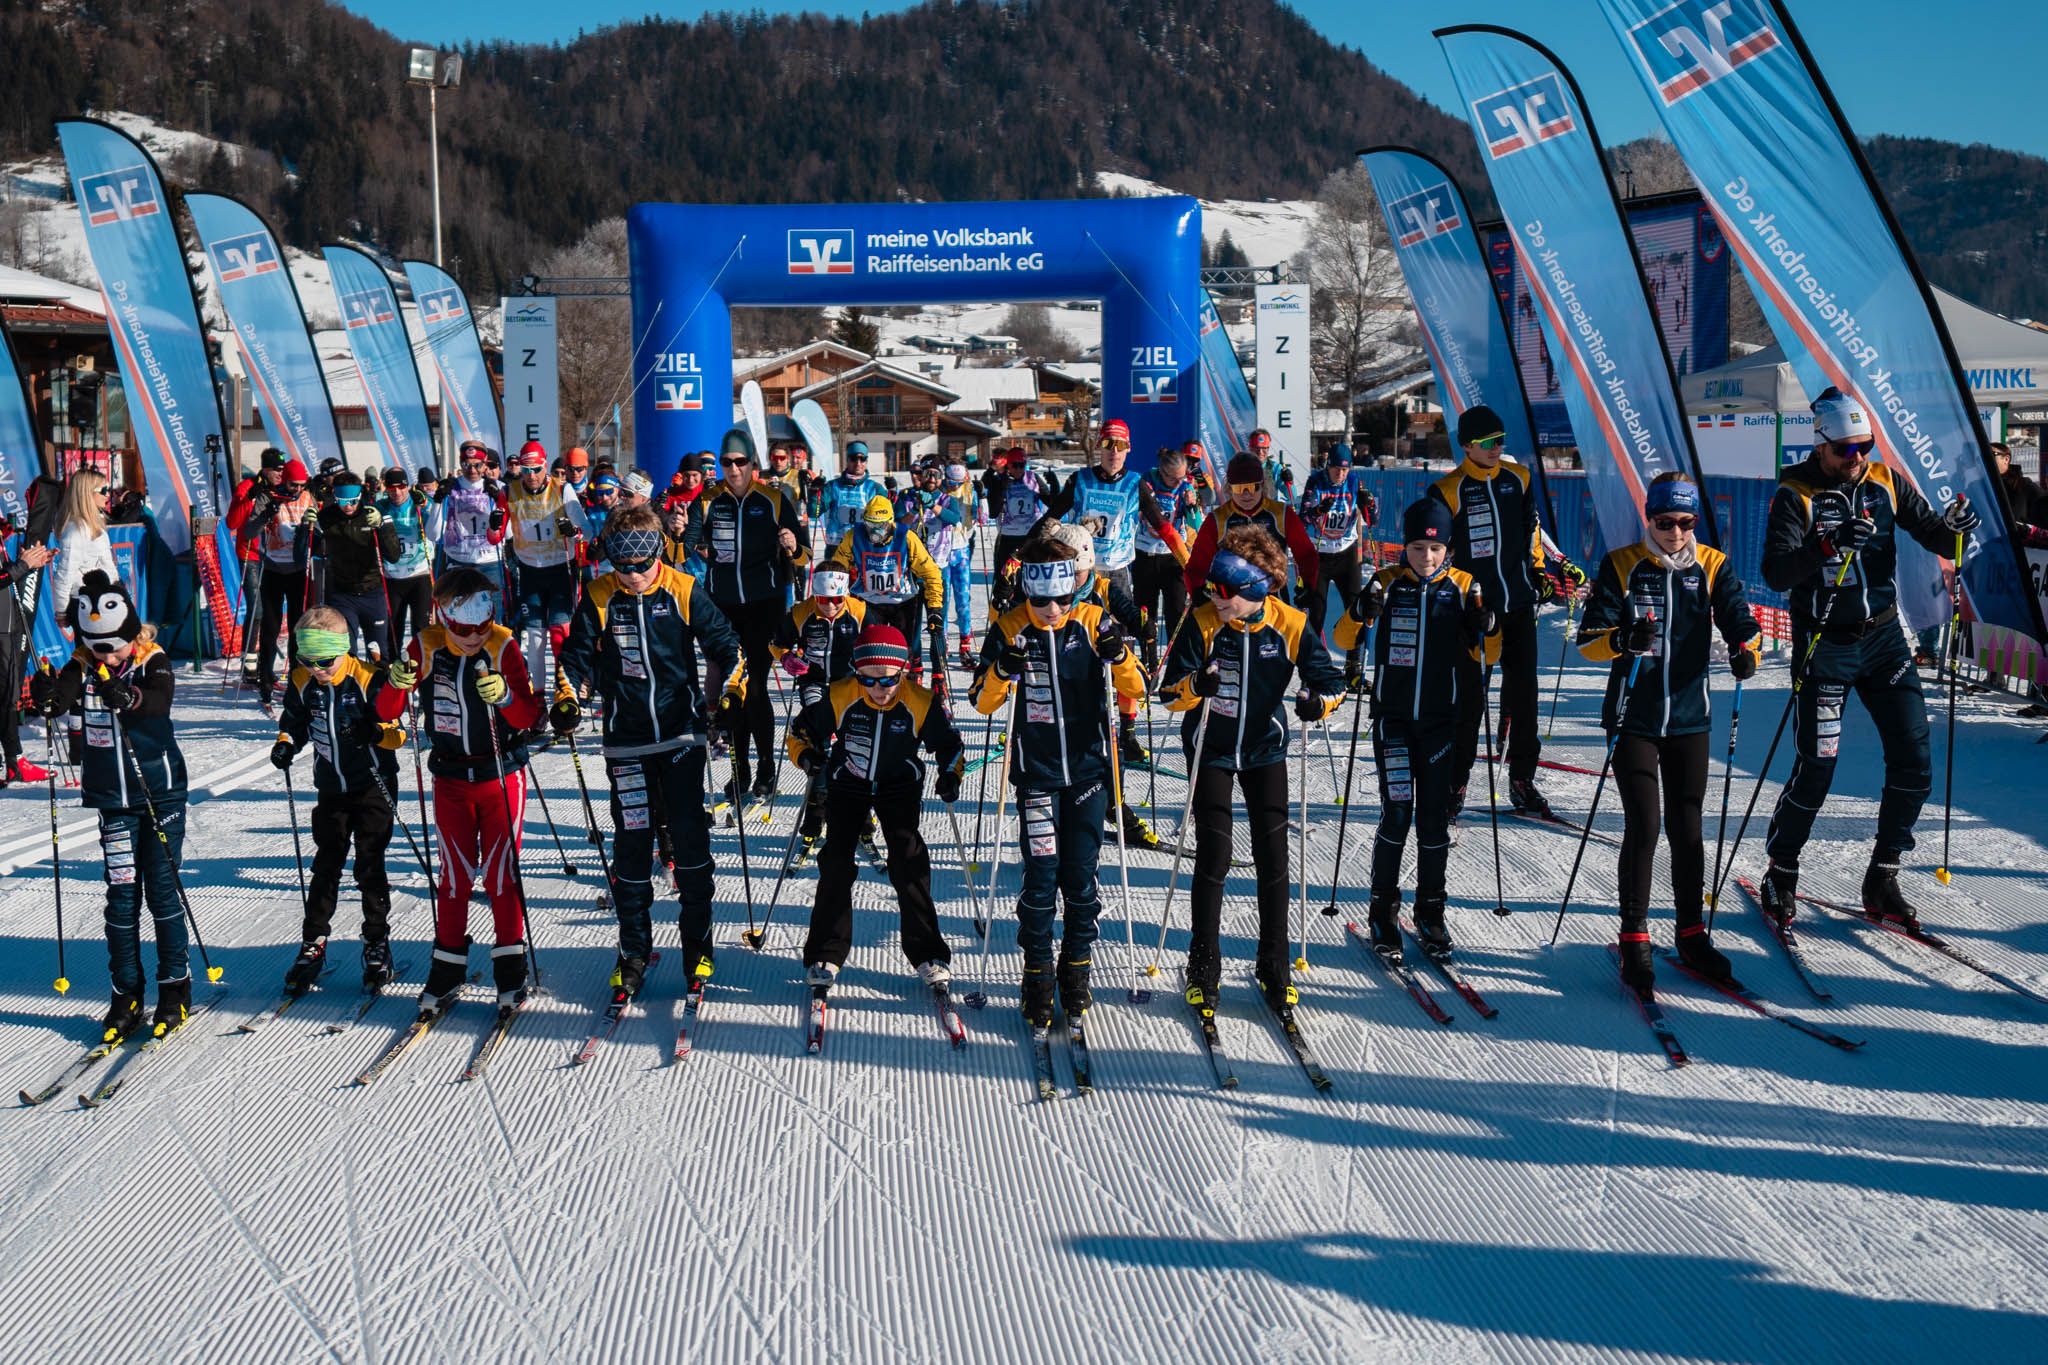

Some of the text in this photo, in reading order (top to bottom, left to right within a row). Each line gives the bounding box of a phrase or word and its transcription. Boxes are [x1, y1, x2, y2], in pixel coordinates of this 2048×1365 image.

[867, 227, 1033, 248] meine Volksbank
[868, 252, 1043, 274] Raiffeisenbank eG
[654, 352, 702, 373] ZIEL
[1131, 346, 1178, 366] ZIEL
[870, 573, 895, 592] 104
